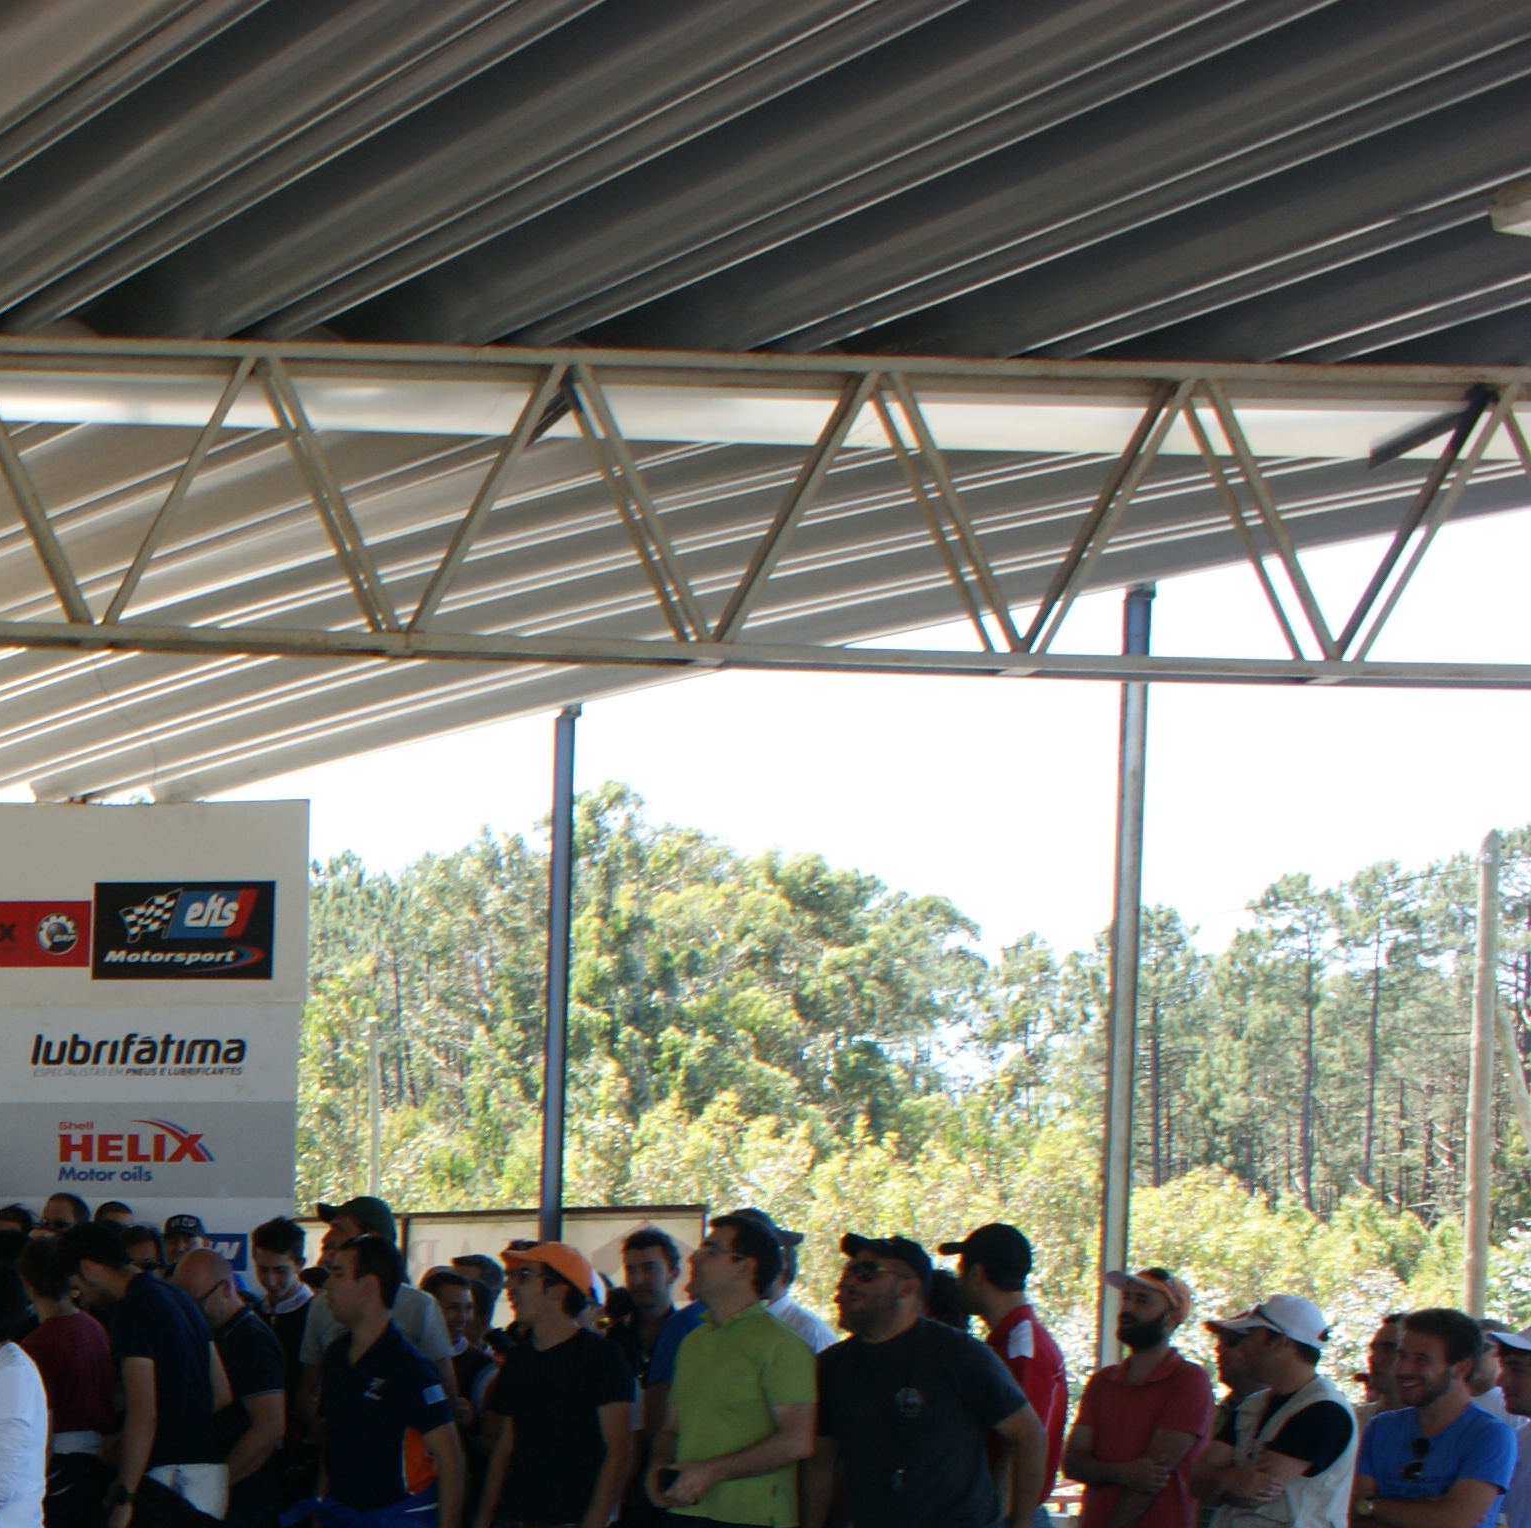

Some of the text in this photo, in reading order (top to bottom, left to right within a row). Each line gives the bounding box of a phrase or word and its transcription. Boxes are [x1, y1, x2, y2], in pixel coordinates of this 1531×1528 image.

[103, 950, 238, 966] Motorsport
[124, 1067, 156, 1076] PNEUS
[168, 1066, 243, 1076] LUBRIFICANTES
[58, 1121, 94, 1131] Shell
[58, 1133, 212, 1163] HELIX
[57, 1165, 152, 1182] Motor oils
